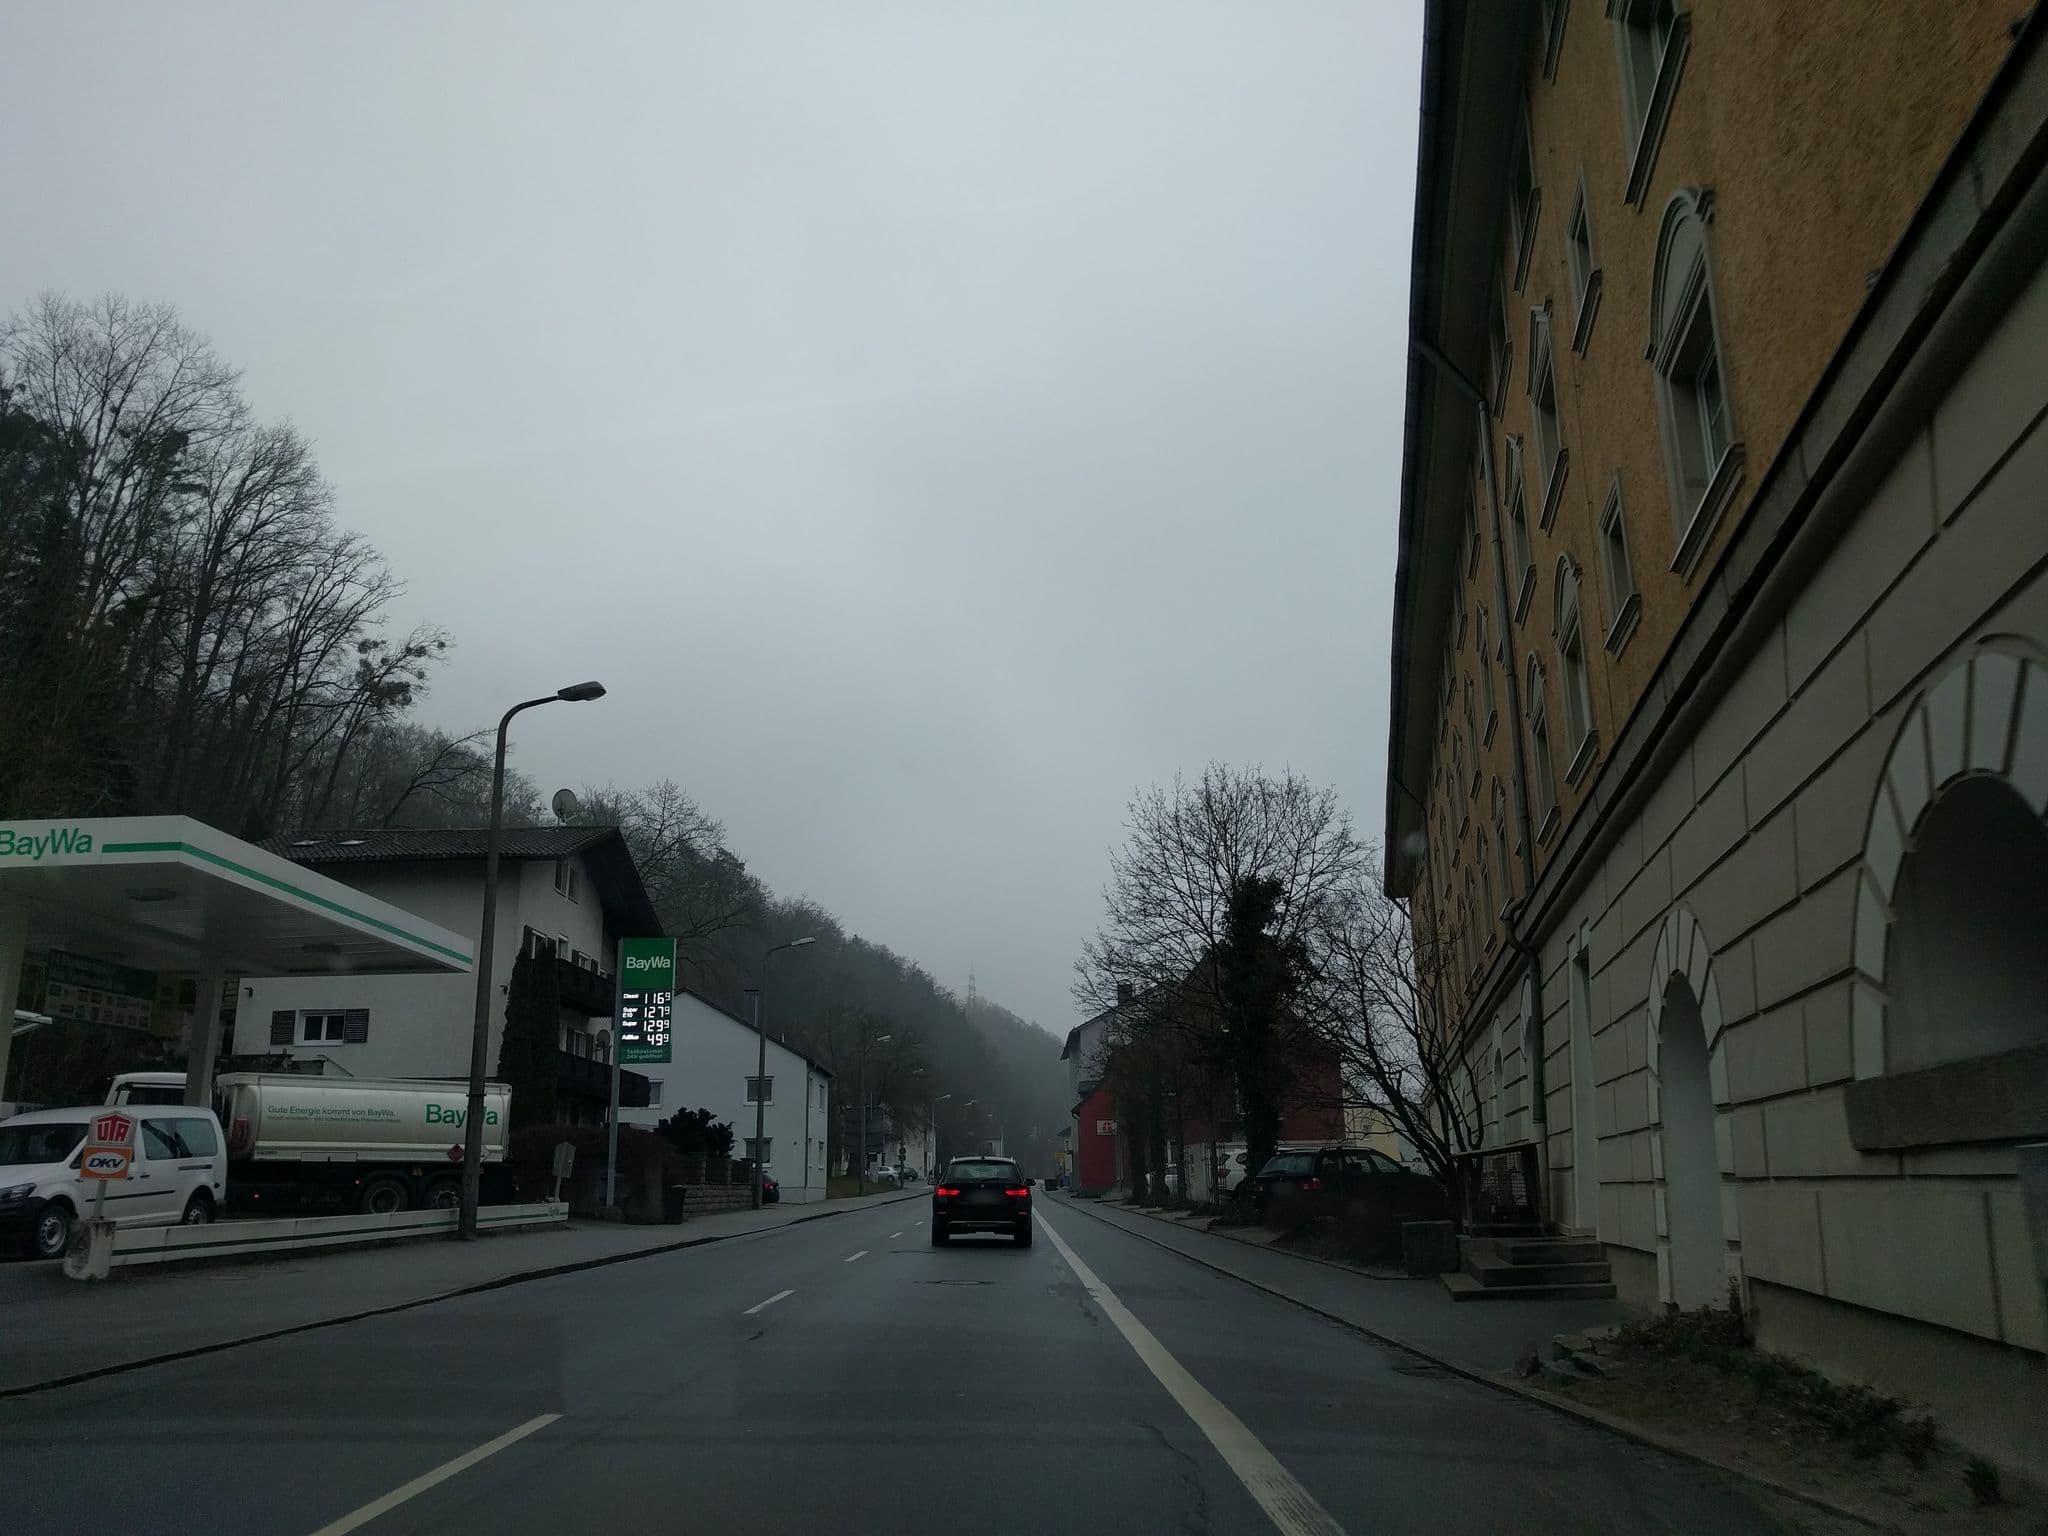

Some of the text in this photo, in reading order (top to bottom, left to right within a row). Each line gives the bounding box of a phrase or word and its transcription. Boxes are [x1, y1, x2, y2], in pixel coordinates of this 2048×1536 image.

[0, 828, 92, 860] BayWa
[626, 956, 671, 971] BayWa
[267, 1105, 288, 1114] Gute
[289, 1105, 321, 1116] Energie
[322, 1106, 350, 1116] kommt
[97, 1115, 131, 1142] UTA
[88, 1158, 124, 1169] DKV
